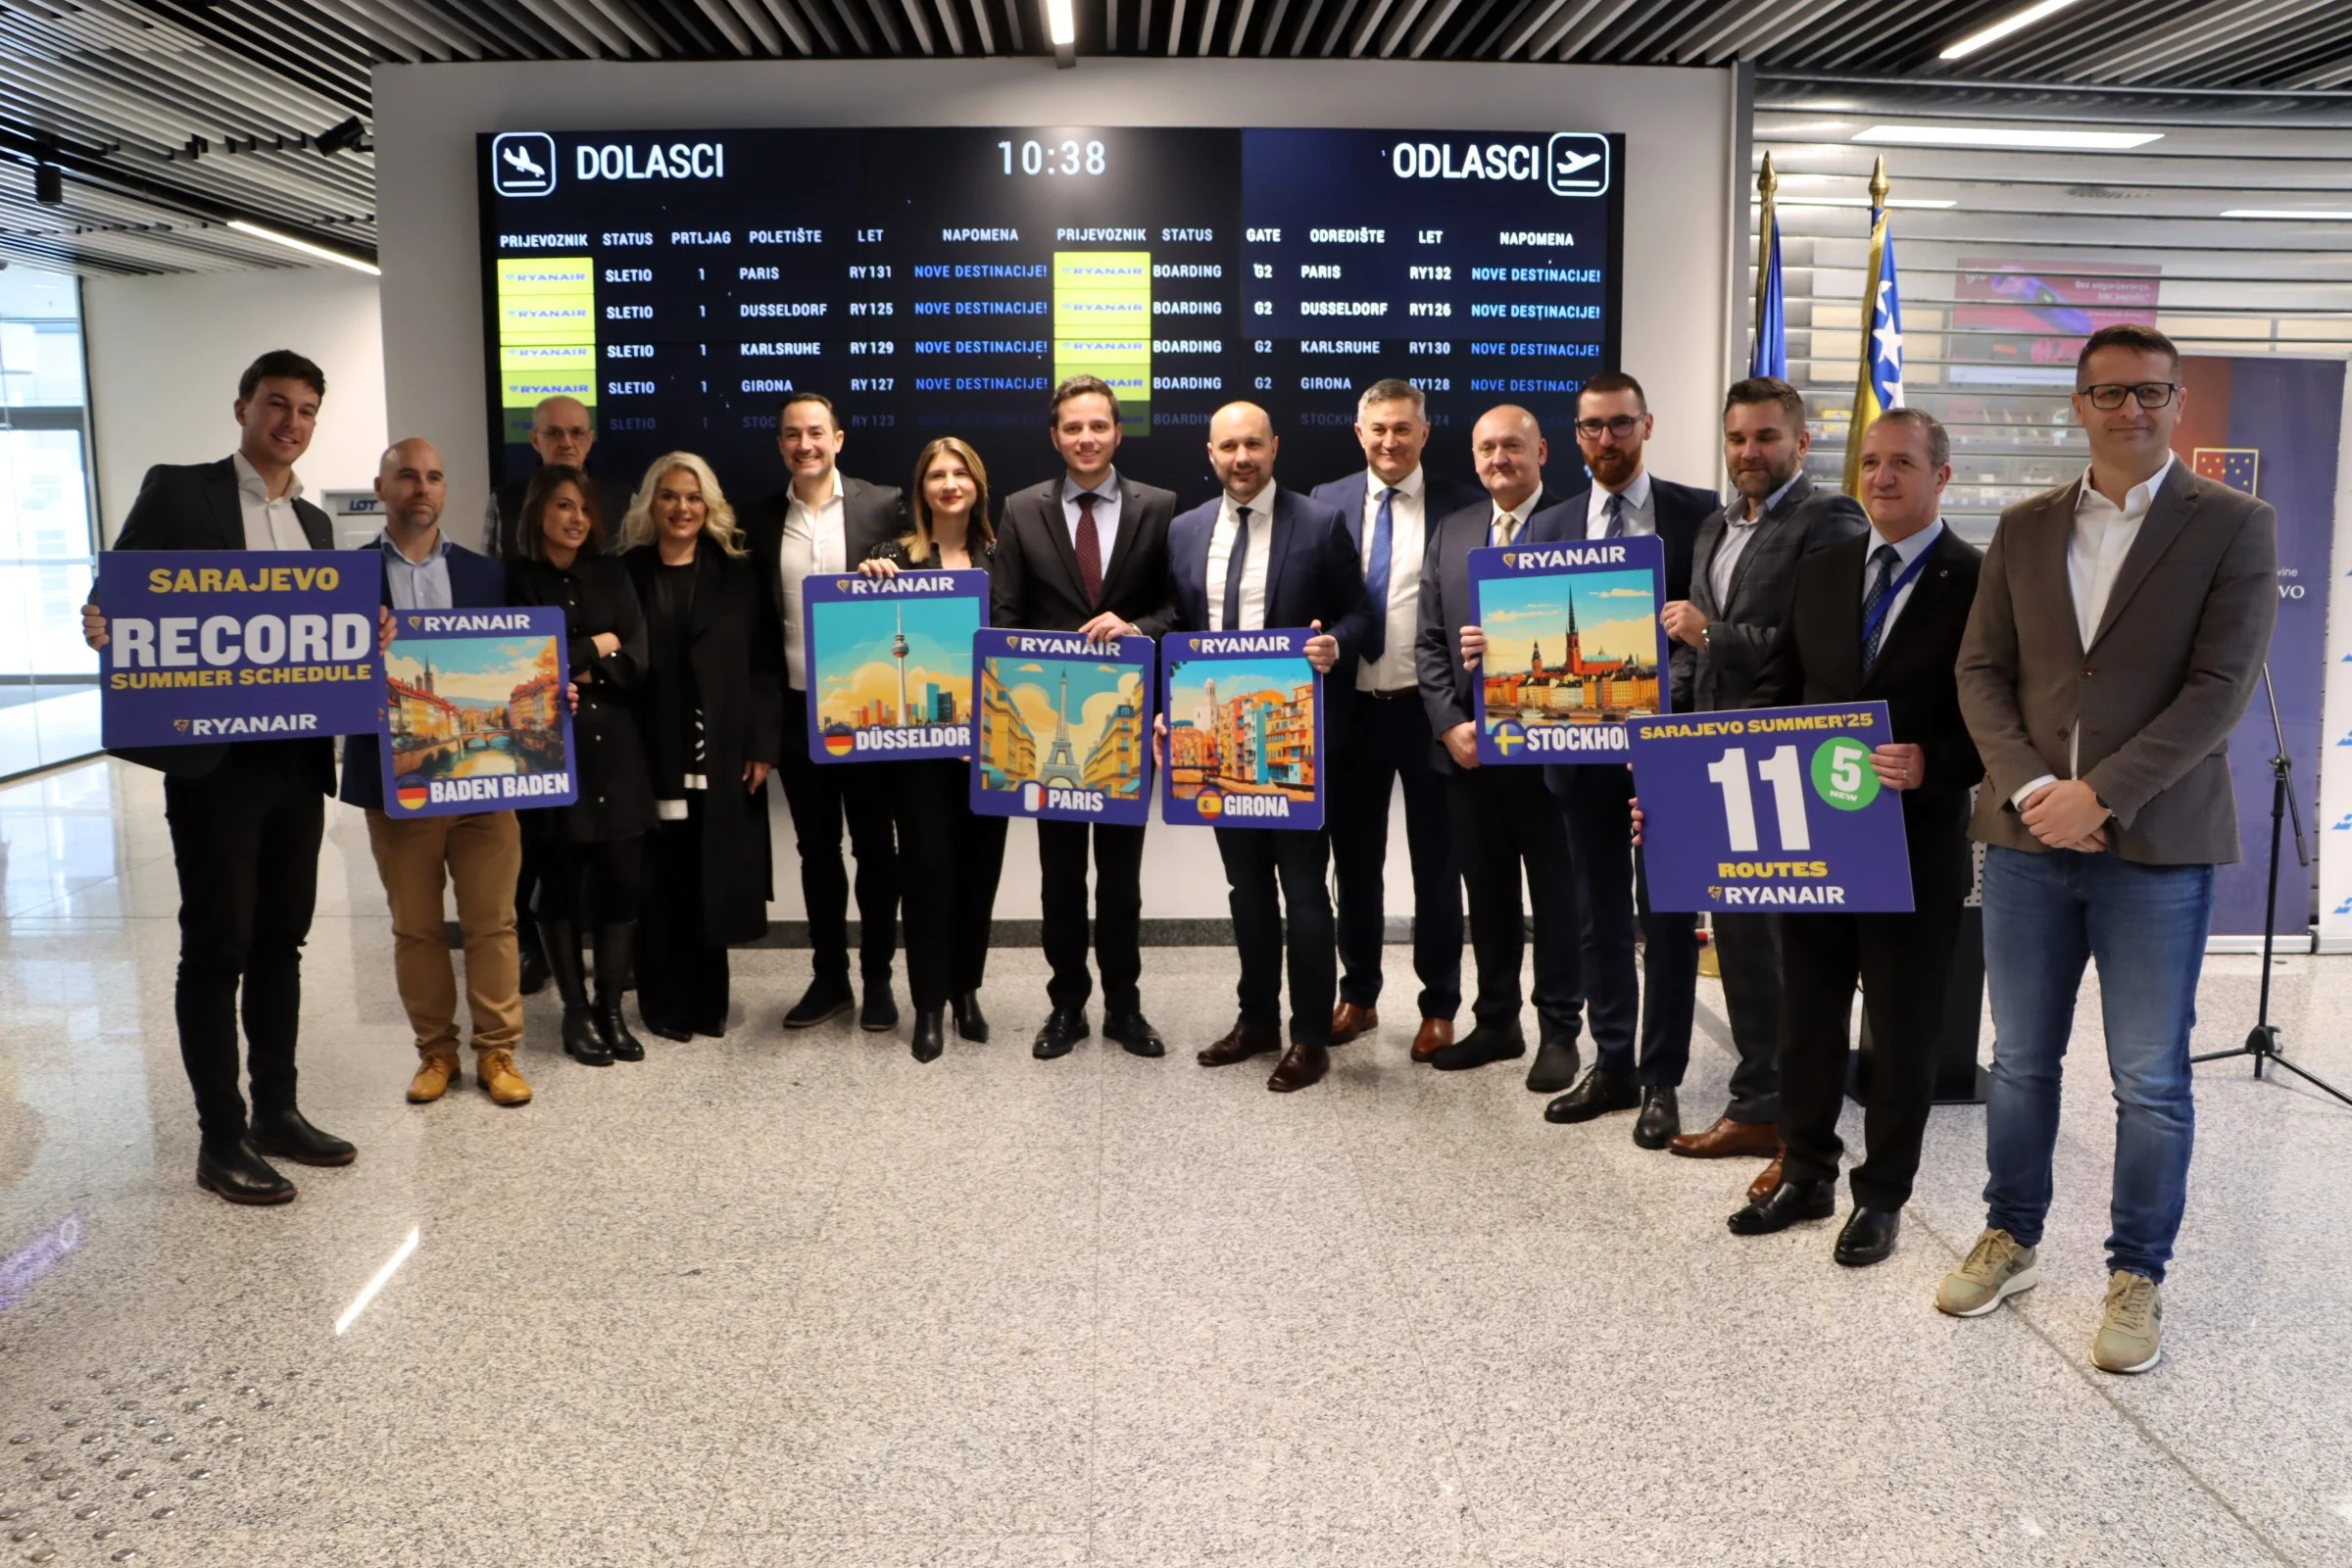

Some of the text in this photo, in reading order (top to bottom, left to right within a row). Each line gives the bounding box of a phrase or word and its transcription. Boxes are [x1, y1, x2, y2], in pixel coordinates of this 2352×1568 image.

[576, 142, 724, 180] DOLASCI
[998, 138, 1106, 179] 10:38
[1393, 142, 1540, 181] ODLASCI
[499, 233, 589, 248] PRIJEVOZNIK
[602, 231, 654, 247] STATUS
[670, 230, 732, 245] PRTLJAG
[749, 226, 822, 244] POLETIŠTE
[858, 228, 884, 243] LET
[942, 227, 1019, 242] NAPOMENA
[1056, 227, 1147, 242] PRIJEVOZNIK
[1161, 227, 1213, 242] STATUS
[1246, 227, 1282, 243] GATE
[1309, 226, 1386, 244] ODREDIŠTE
[1418, 229, 1444, 244] LET
[1499, 231, 1575, 247] NAPOMENA
[605, 268, 653, 283] SLETIO
[698, 268, 706, 281] 1
[739, 267, 780, 280] PARIS
[914, 265, 951, 278] NOVE
[955, 264, 1048, 278] DESTINACIJE!
[1152, 264, 1222, 278] BOARDING
[1252, 263, 1273, 279] G2
[1300, 265, 1342, 279] PARIS
[1471, 267, 1508, 281] NOVE
[1510, 268, 1601, 283] DESTINACIJE!
[606, 305, 654, 319] SLETIO
[699, 305, 706, 318] 1
[740, 303, 828, 318] DUSSELDORF
[914, 302, 952, 316] NOVE
[955, 301, 1048, 315] DESTINACIJE!
[1152, 301, 1222, 316] BOARDING
[1253, 301, 1273, 316] G2
[1300, 301, 1389, 317] DUSSELDORF
[1471, 304, 1507, 318] NOVE
[1510, 304, 1600, 320] DESTINACIJE!
[607, 344, 655, 359] SLETIO
[700, 343, 707, 357] 1
[740, 341, 821, 357] KARLSRUHE
[914, 340, 952, 354] NOVE
[955, 340, 1048, 354] DESTINACIJE!
[1152, 339, 1222, 354] BOARDING
[1254, 339, 1273, 354] G2
[1300, 340, 1381, 354] KARLSRUHE
[1471, 342, 1506, 356] NOVE
[1510, 342, 1600, 358] DESTINACIJE!
[520, 384, 588, 393] RYANAIR
[608, 380, 656, 395] SLETIO
[701, 380, 708, 393] 1
[741, 378, 794, 393] GIRONA
[915, 377, 952, 391] NOVE
[956, 376, 1049, 391] DESTINACIJE!
[1152, 376, 1222, 390] BOARDING
[1254, 376, 1272, 390] G2
[1300, 376, 1352, 390] GIRONA
[1471, 379, 1505, 391] NOVE
[1510, 379, 1587, 392] DESTINACI
[610, 416, 657, 430] SLETIO
[1153, 414, 1211, 424] BOARDIN
[349, 500, 378, 512] LOT
[1518, 545, 1626, 570] RYANAIR
[148, 566, 339, 594] SARAJEVO
[852, 574, 956, 595] RYANAIR
[423, 613, 531, 632] RYANAIR
[112, 614, 371, 668] RECORD
[1020, 637, 1121, 657] RYANAIR
[1201, 635, 1291, 654] RYANAIR
[111, 665, 371, 690] SUMMER SCHEDULE
[192, 713, 318, 736] RYANAIR
[1641, 712, 1873, 740] SARAJEVO SUMMER'25
[857, 726, 970, 751] DÜSSELDOR
[1526, 726, 1630, 751] STOCKHO
[1831, 745, 1863, 792] 5
[430, 772, 569, 804] BADEN BADEN
[1830, 790, 1858, 802] NEW
[1049, 789, 1102, 812] PARIS
[1224, 795, 1290, 818] GIRONA
[1707, 745, 1811, 853] 11
[1718, 861, 1828, 878] ROUTES
[1724, 886, 1845, 905] RYANAIR
